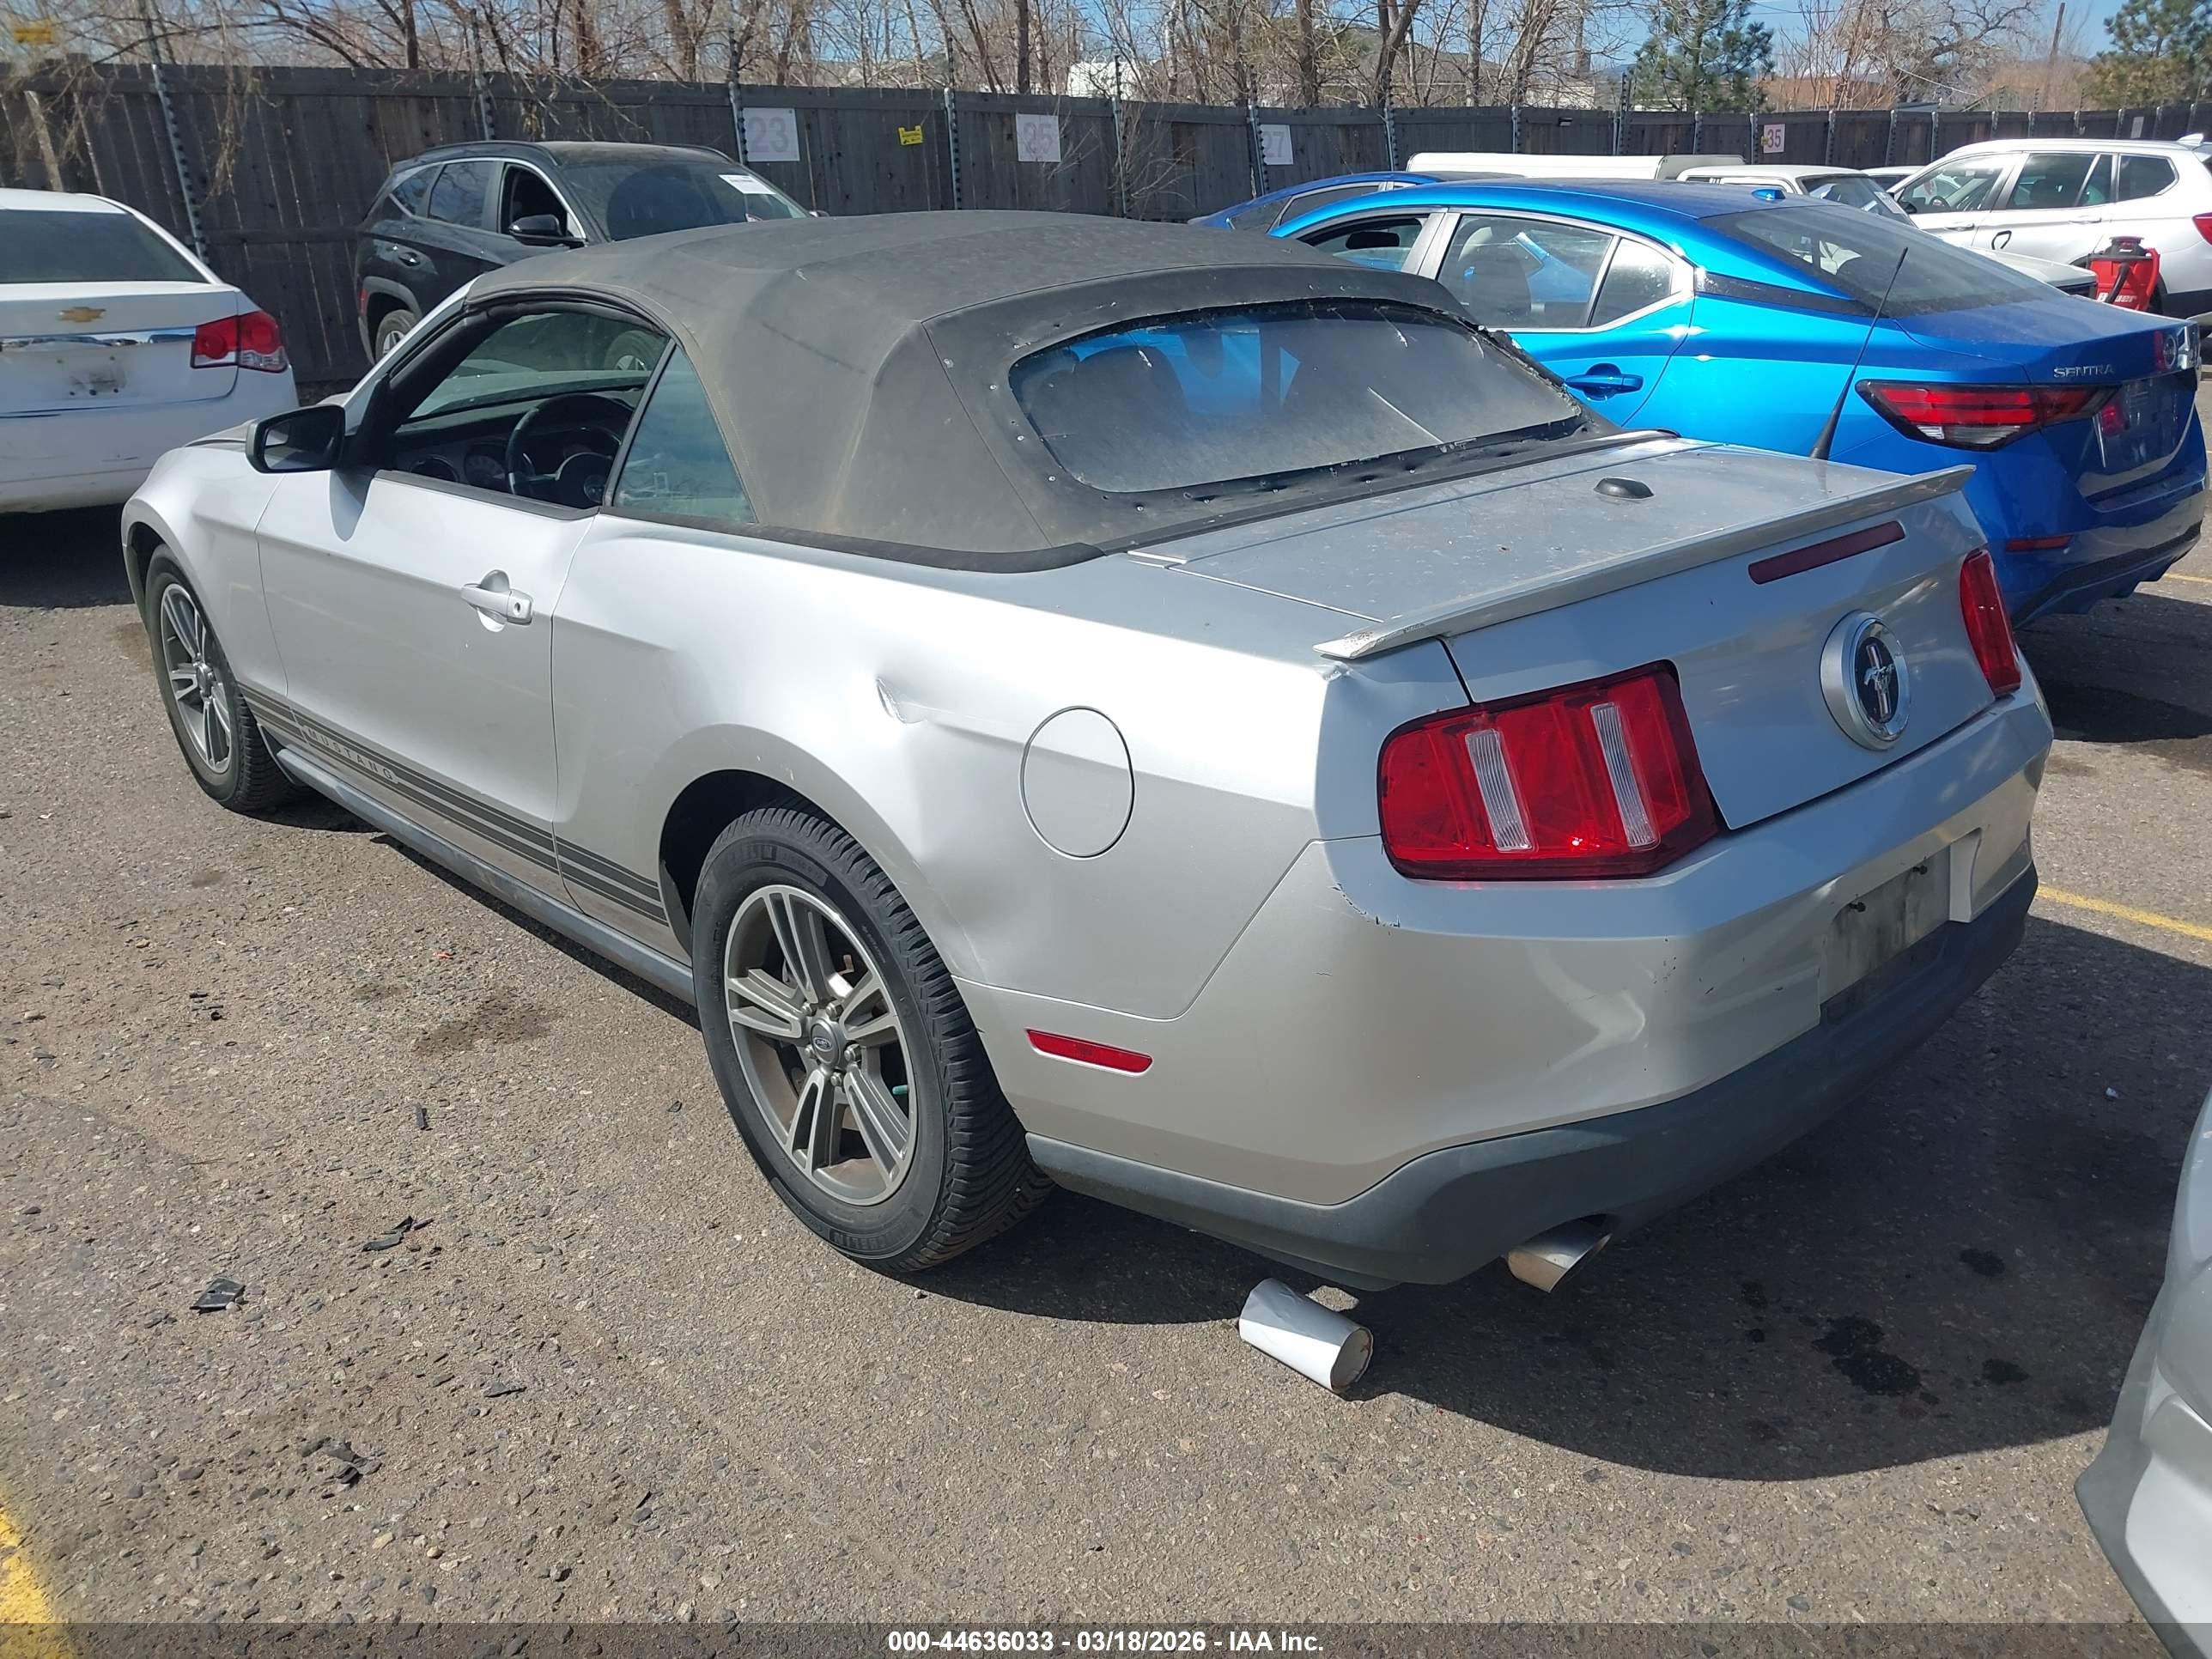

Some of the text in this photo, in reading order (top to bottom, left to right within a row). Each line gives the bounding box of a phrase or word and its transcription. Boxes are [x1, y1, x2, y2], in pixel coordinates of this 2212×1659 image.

[747, 117, 789, 153] 23
[1767, 129, 1782, 148] 35
[2053, 364, 2115, 378] SENTRA
[308, 729, 393, 780] MUSTANG
